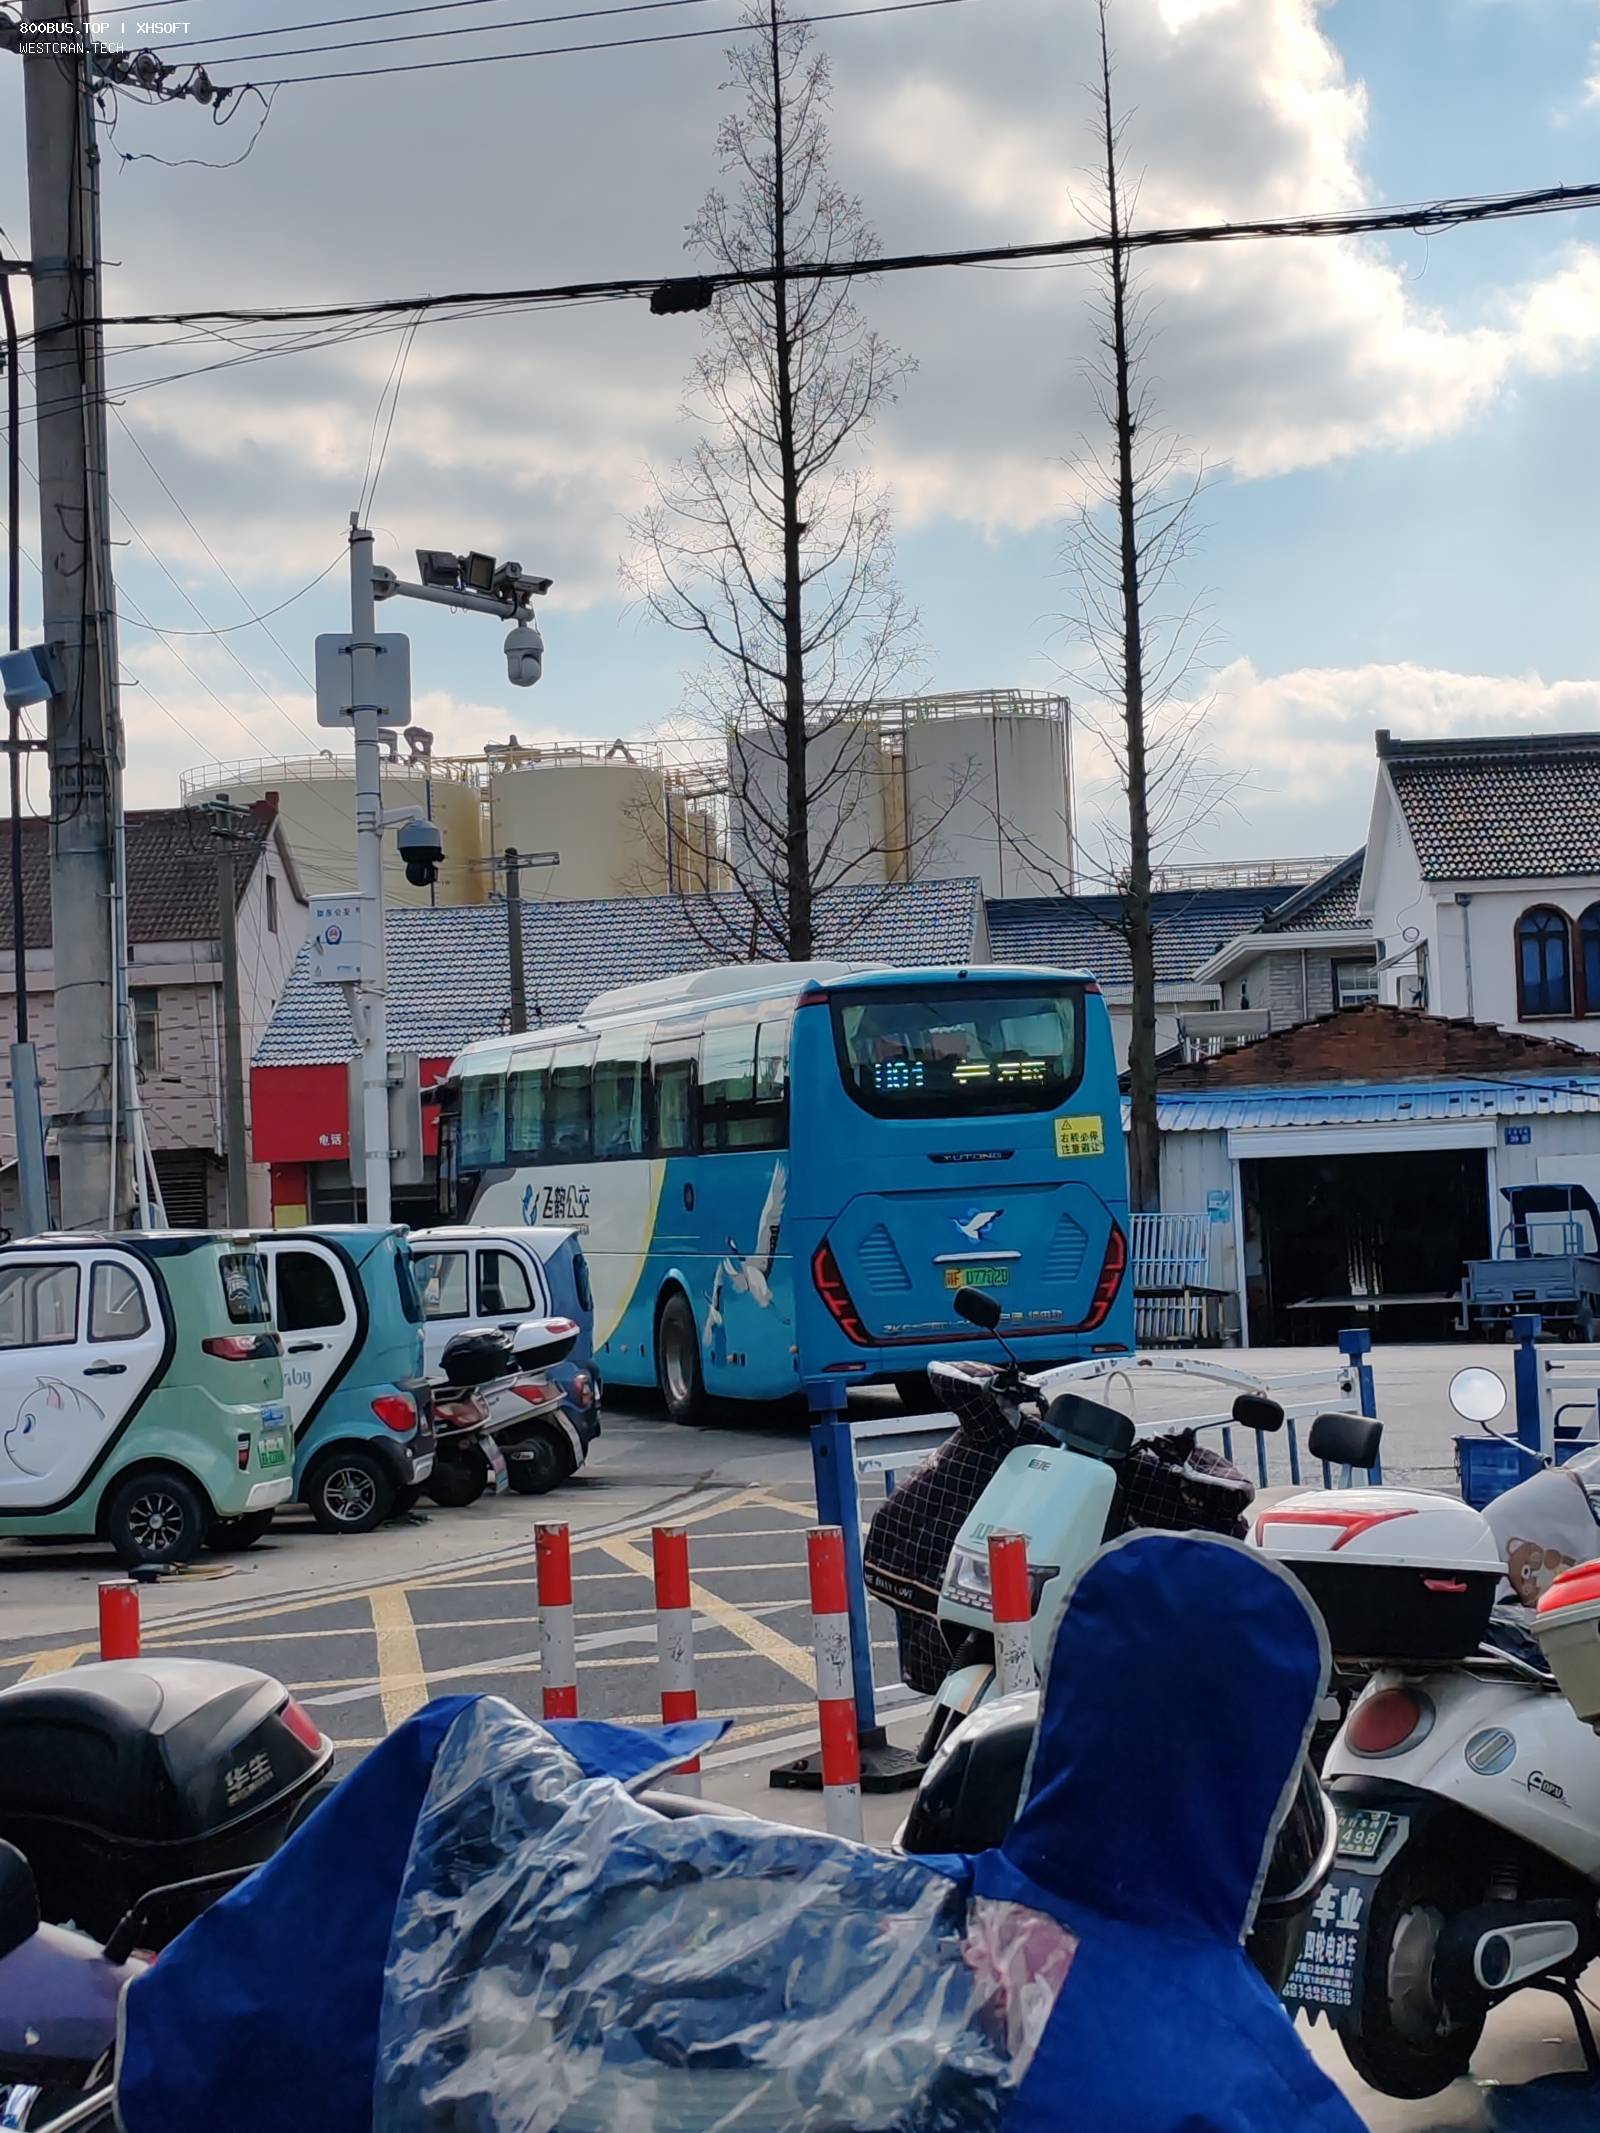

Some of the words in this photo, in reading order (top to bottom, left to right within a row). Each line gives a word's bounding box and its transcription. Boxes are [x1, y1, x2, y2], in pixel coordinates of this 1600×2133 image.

[319, 1133, 342, 1146] 电话
[943, 1152, 1003, 1161] YUTONG
[225, 1752, 272, 1793] 华生
